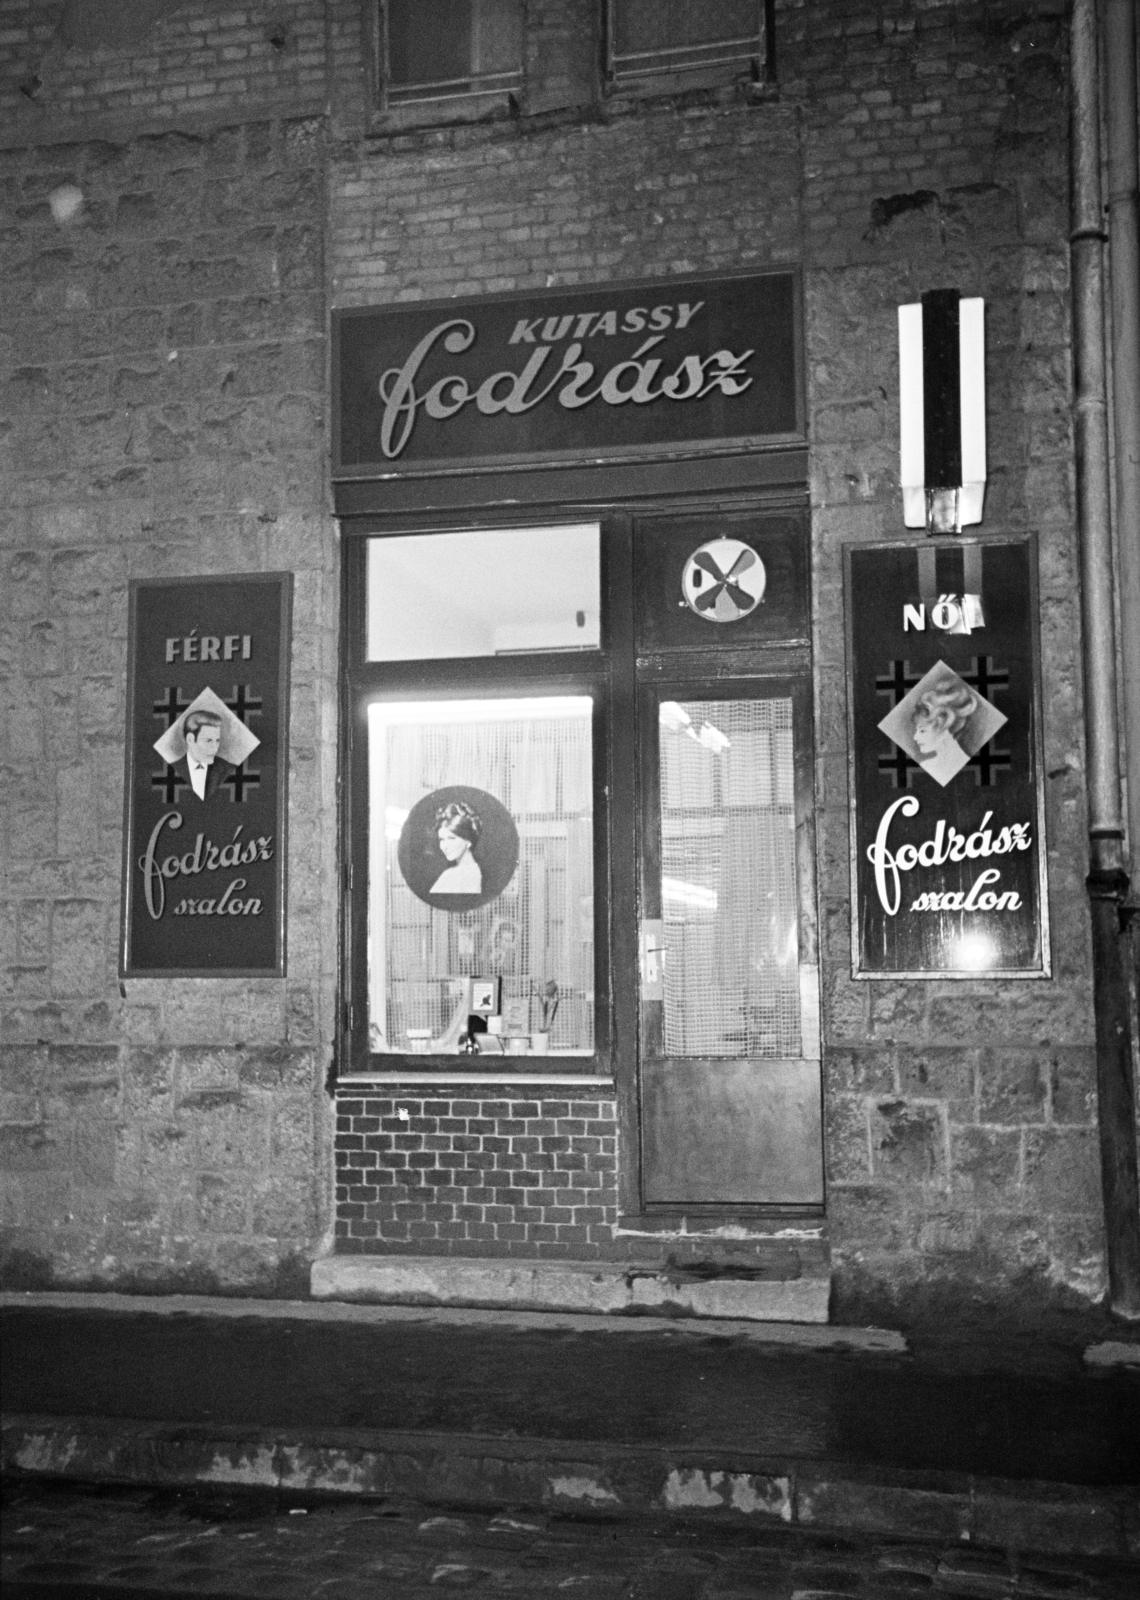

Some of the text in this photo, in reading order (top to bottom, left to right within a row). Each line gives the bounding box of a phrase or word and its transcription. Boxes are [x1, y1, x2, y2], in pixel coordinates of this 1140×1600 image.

[508, 301, 704, 345] KUTASSY
[379, 318, 754, 458] fodrász
[165, 629, 252, 663] FÉRFI
[138, 811, 273, 920] fodrász
[867, 796, 1032, 916] fodrász
[173, 878, 264, 916] szalon
[911, 869, 1022, 912] szalon
